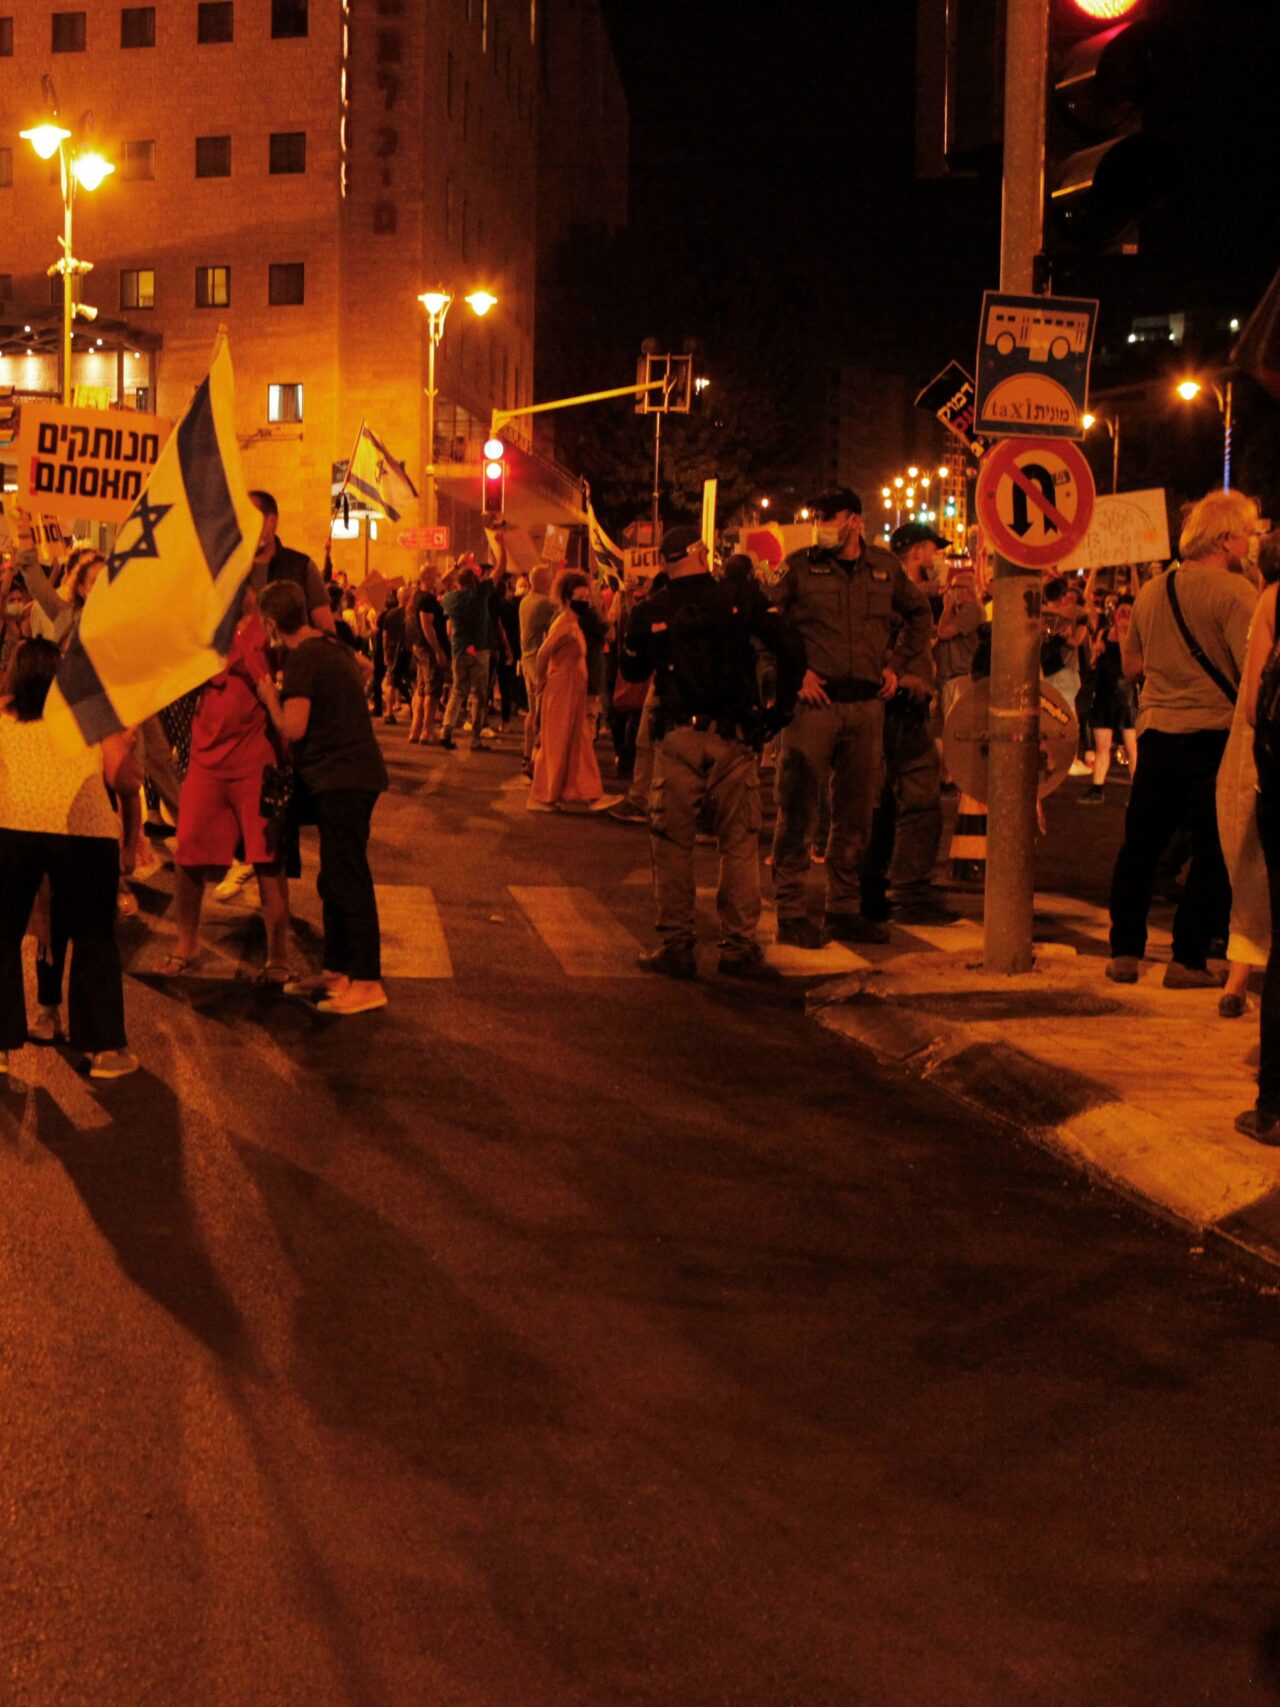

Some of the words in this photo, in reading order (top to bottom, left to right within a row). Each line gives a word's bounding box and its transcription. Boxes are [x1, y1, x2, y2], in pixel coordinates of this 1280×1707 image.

[992, 397, 1032, 420] taxi
[1034, 404, 1070, 423] מונית
[37, 422, 159, 464] מנותקים
[30, 456, 150, 500] מאסתם!
